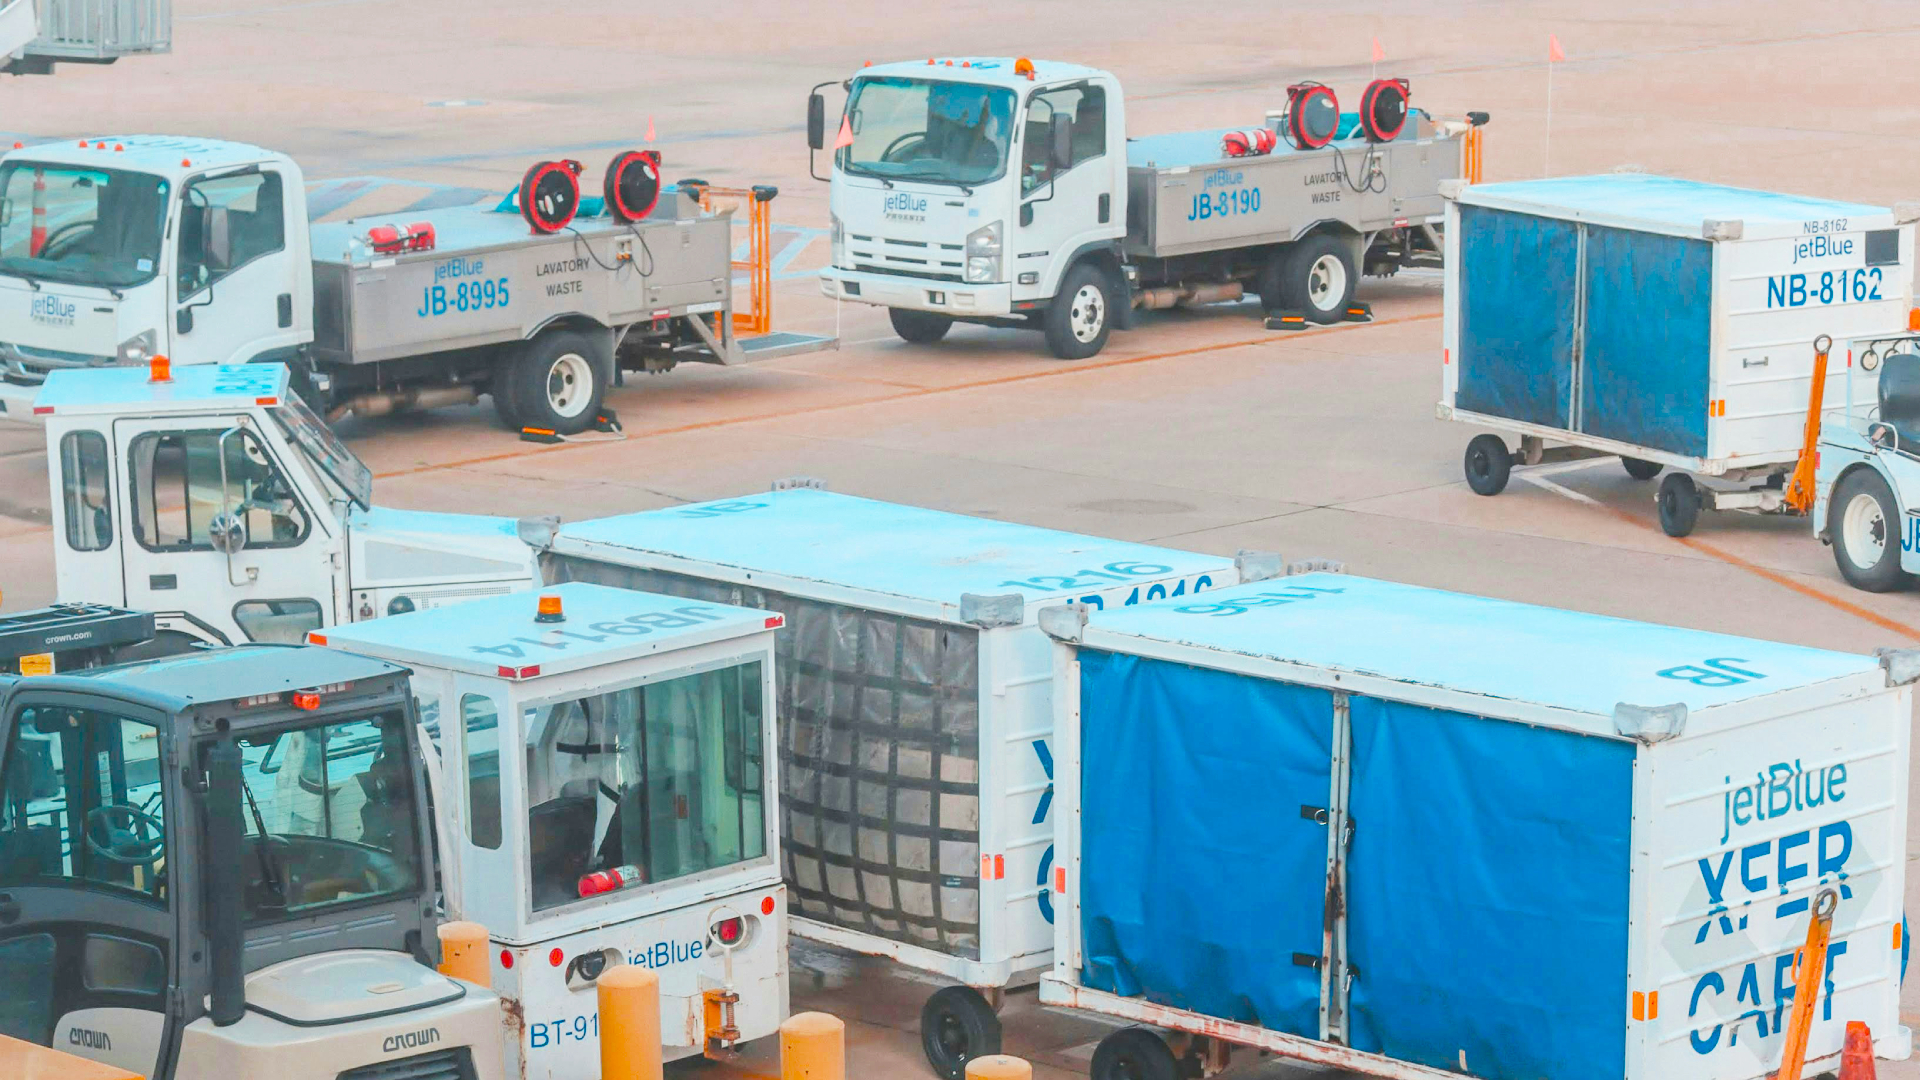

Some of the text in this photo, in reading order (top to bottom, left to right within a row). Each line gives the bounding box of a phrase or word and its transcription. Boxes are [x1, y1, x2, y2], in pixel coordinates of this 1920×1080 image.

[1203, 169, 1244, 191] jetBlue
[1304, 171, 1347, 186] LAVATORY
[883, 193, 927, 213] jetBlue
[1188, 187, 1261, 221] JB-8190
[1311, 191, 1341, 204] WASTE
[1804, 218, 1848, 234] NB-8162
[1793, 235, 1853, 264] jetBlue
[434, 258, 484, 284] jetBlue
[536, 257, 590, 277] LAVATORY
[417, 277, 510, 318] JB-8995
[546, 280, 583, 297] WASTE
[1767, 267, 1883, 309] NB-8162
[30, 295, 76, 318] jetBlue
[997, 561, 1174, 592] 1216
[1173, 585, 1347, 617] 1156
[45, 631, 92, 644] crown.com
[468, 605, 727, 658] JB9114
[1656, 657, 1770, 687] JB
[1720, 758, 1848, 845] jetBlue
[1694, 820, 1854, 944] XFER
[628, 940, 703, 968] jetBlue
